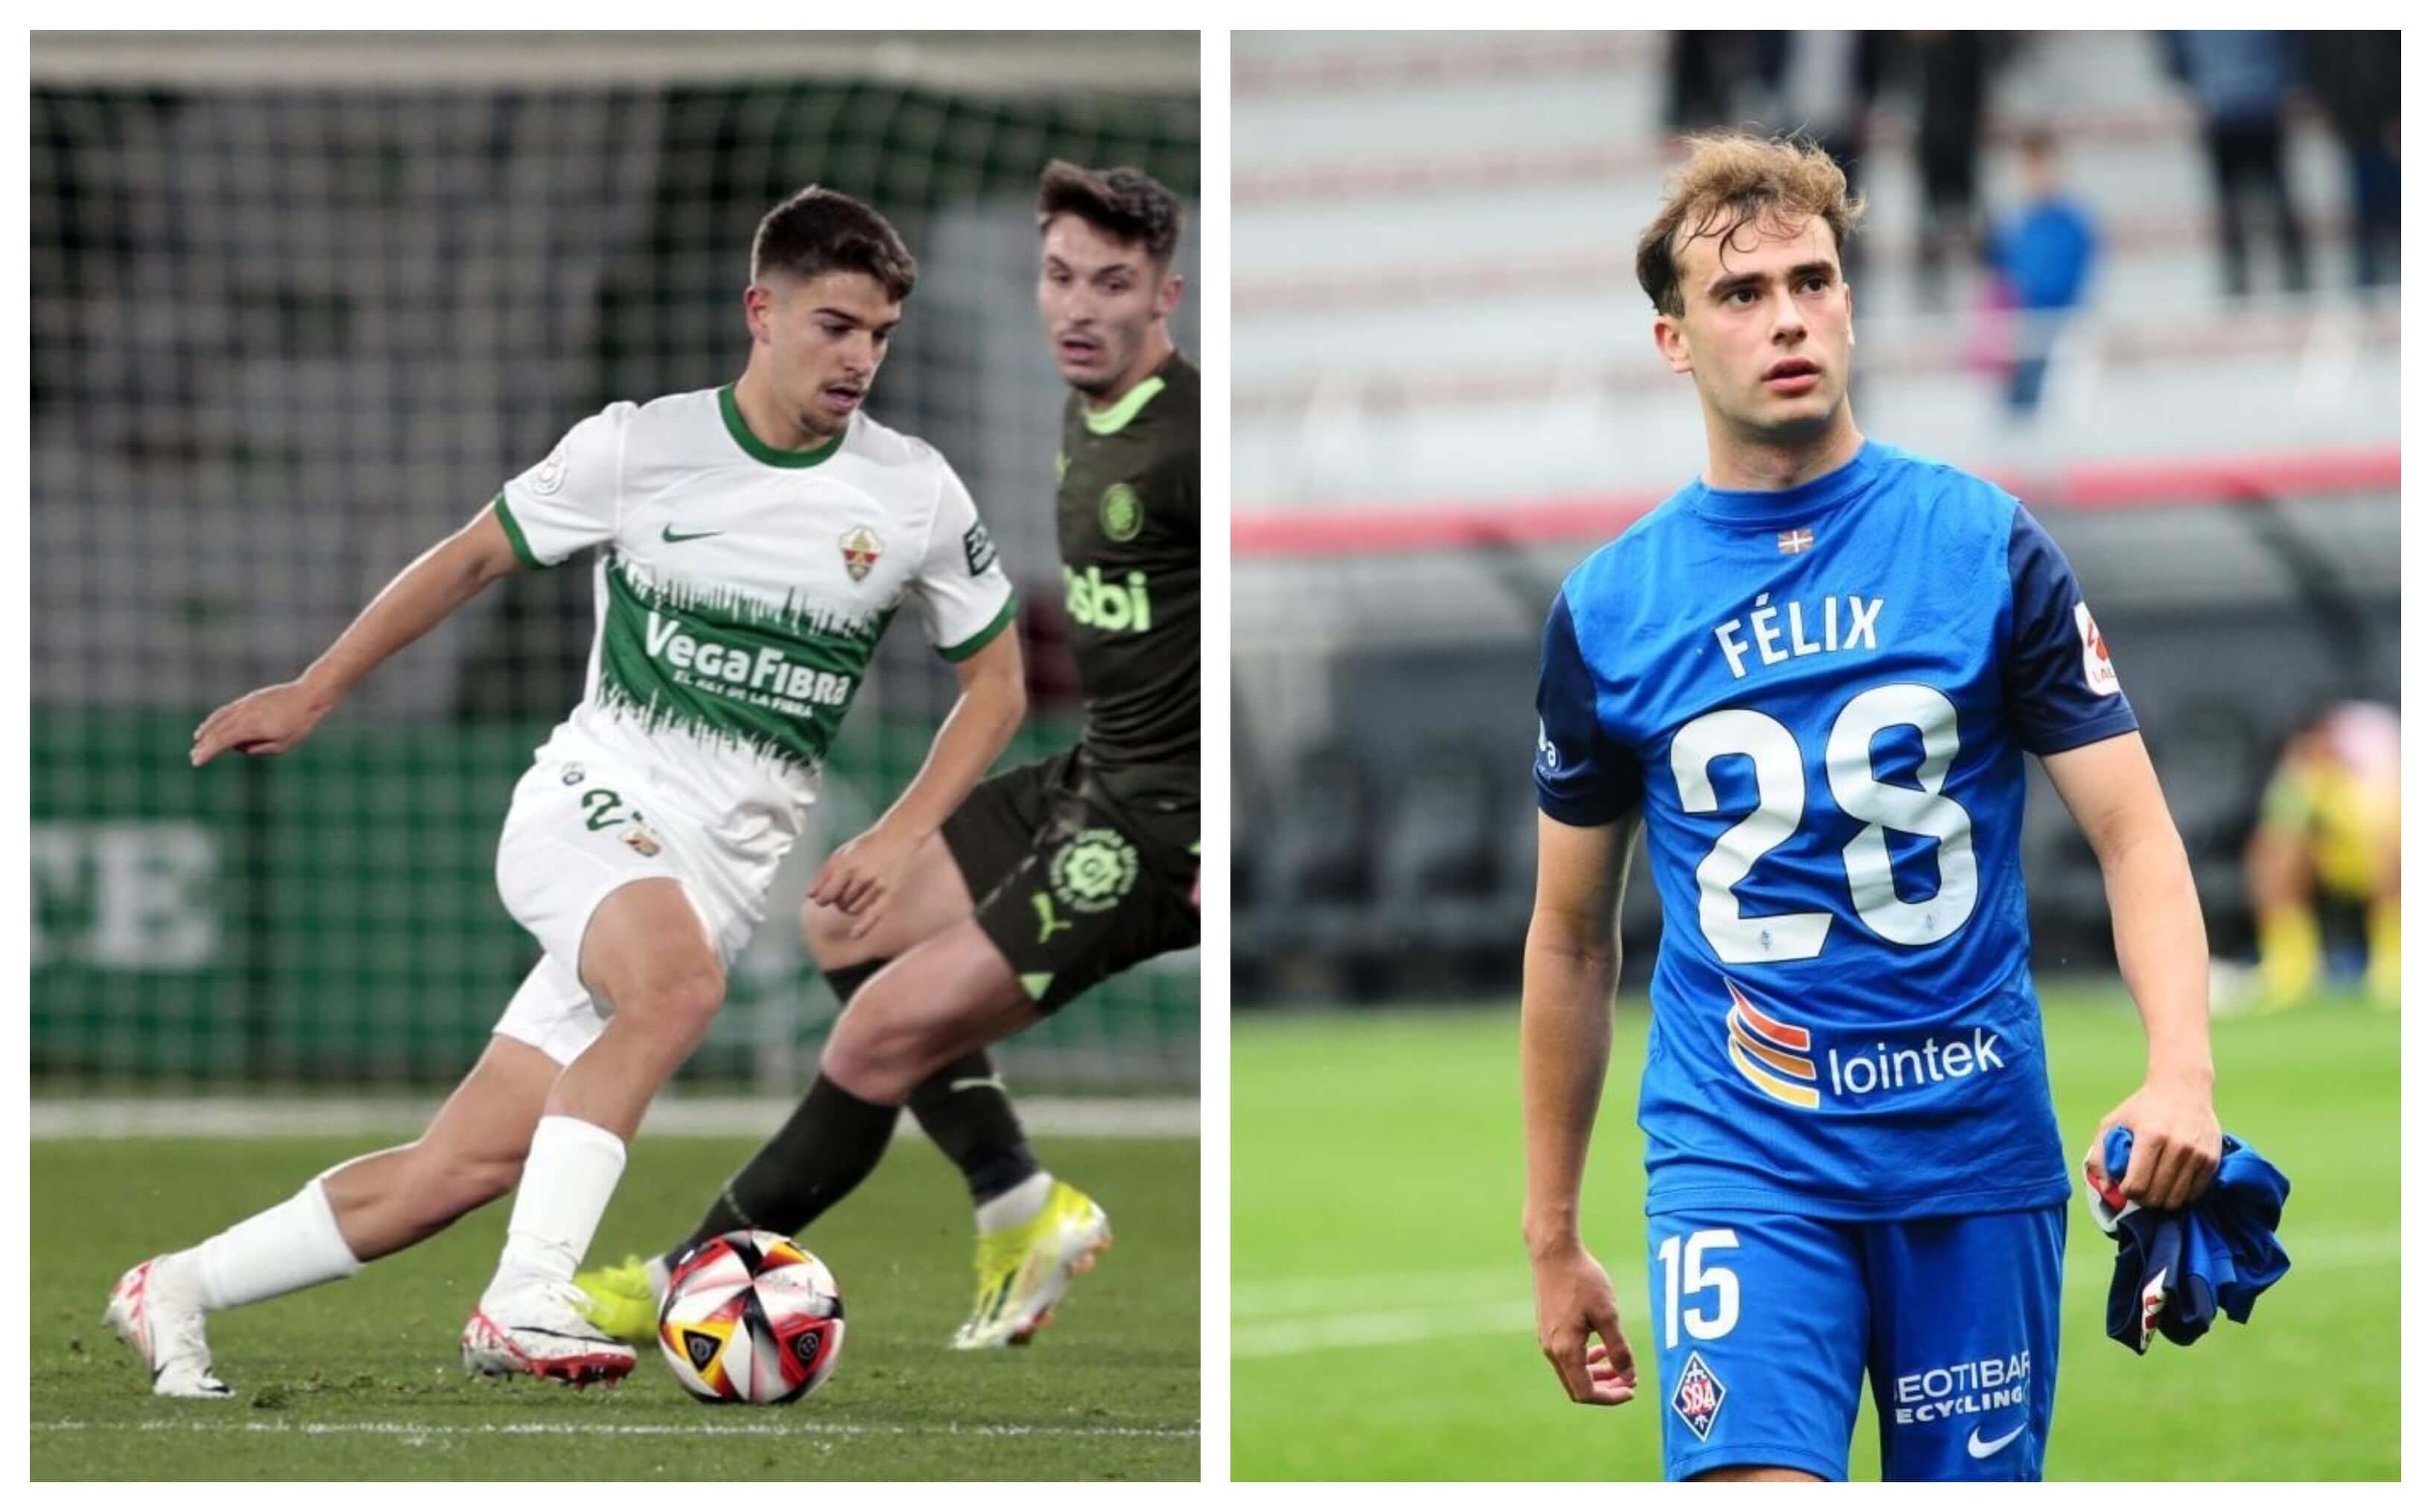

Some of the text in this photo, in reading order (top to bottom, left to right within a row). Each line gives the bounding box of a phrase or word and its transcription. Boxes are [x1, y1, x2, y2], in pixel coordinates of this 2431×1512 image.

[1715, 592, 1884, 679] FÉLIX
[1671, 683, 1979, 965] 28
[1828, 1027, 2005, 1096] lointek
[1656, 1229, 1740, 1350] 15
[1893, 1349, 2031, 1403] EOTIBAR
[1895, 1385, 2022, 1424] ECYCLING
